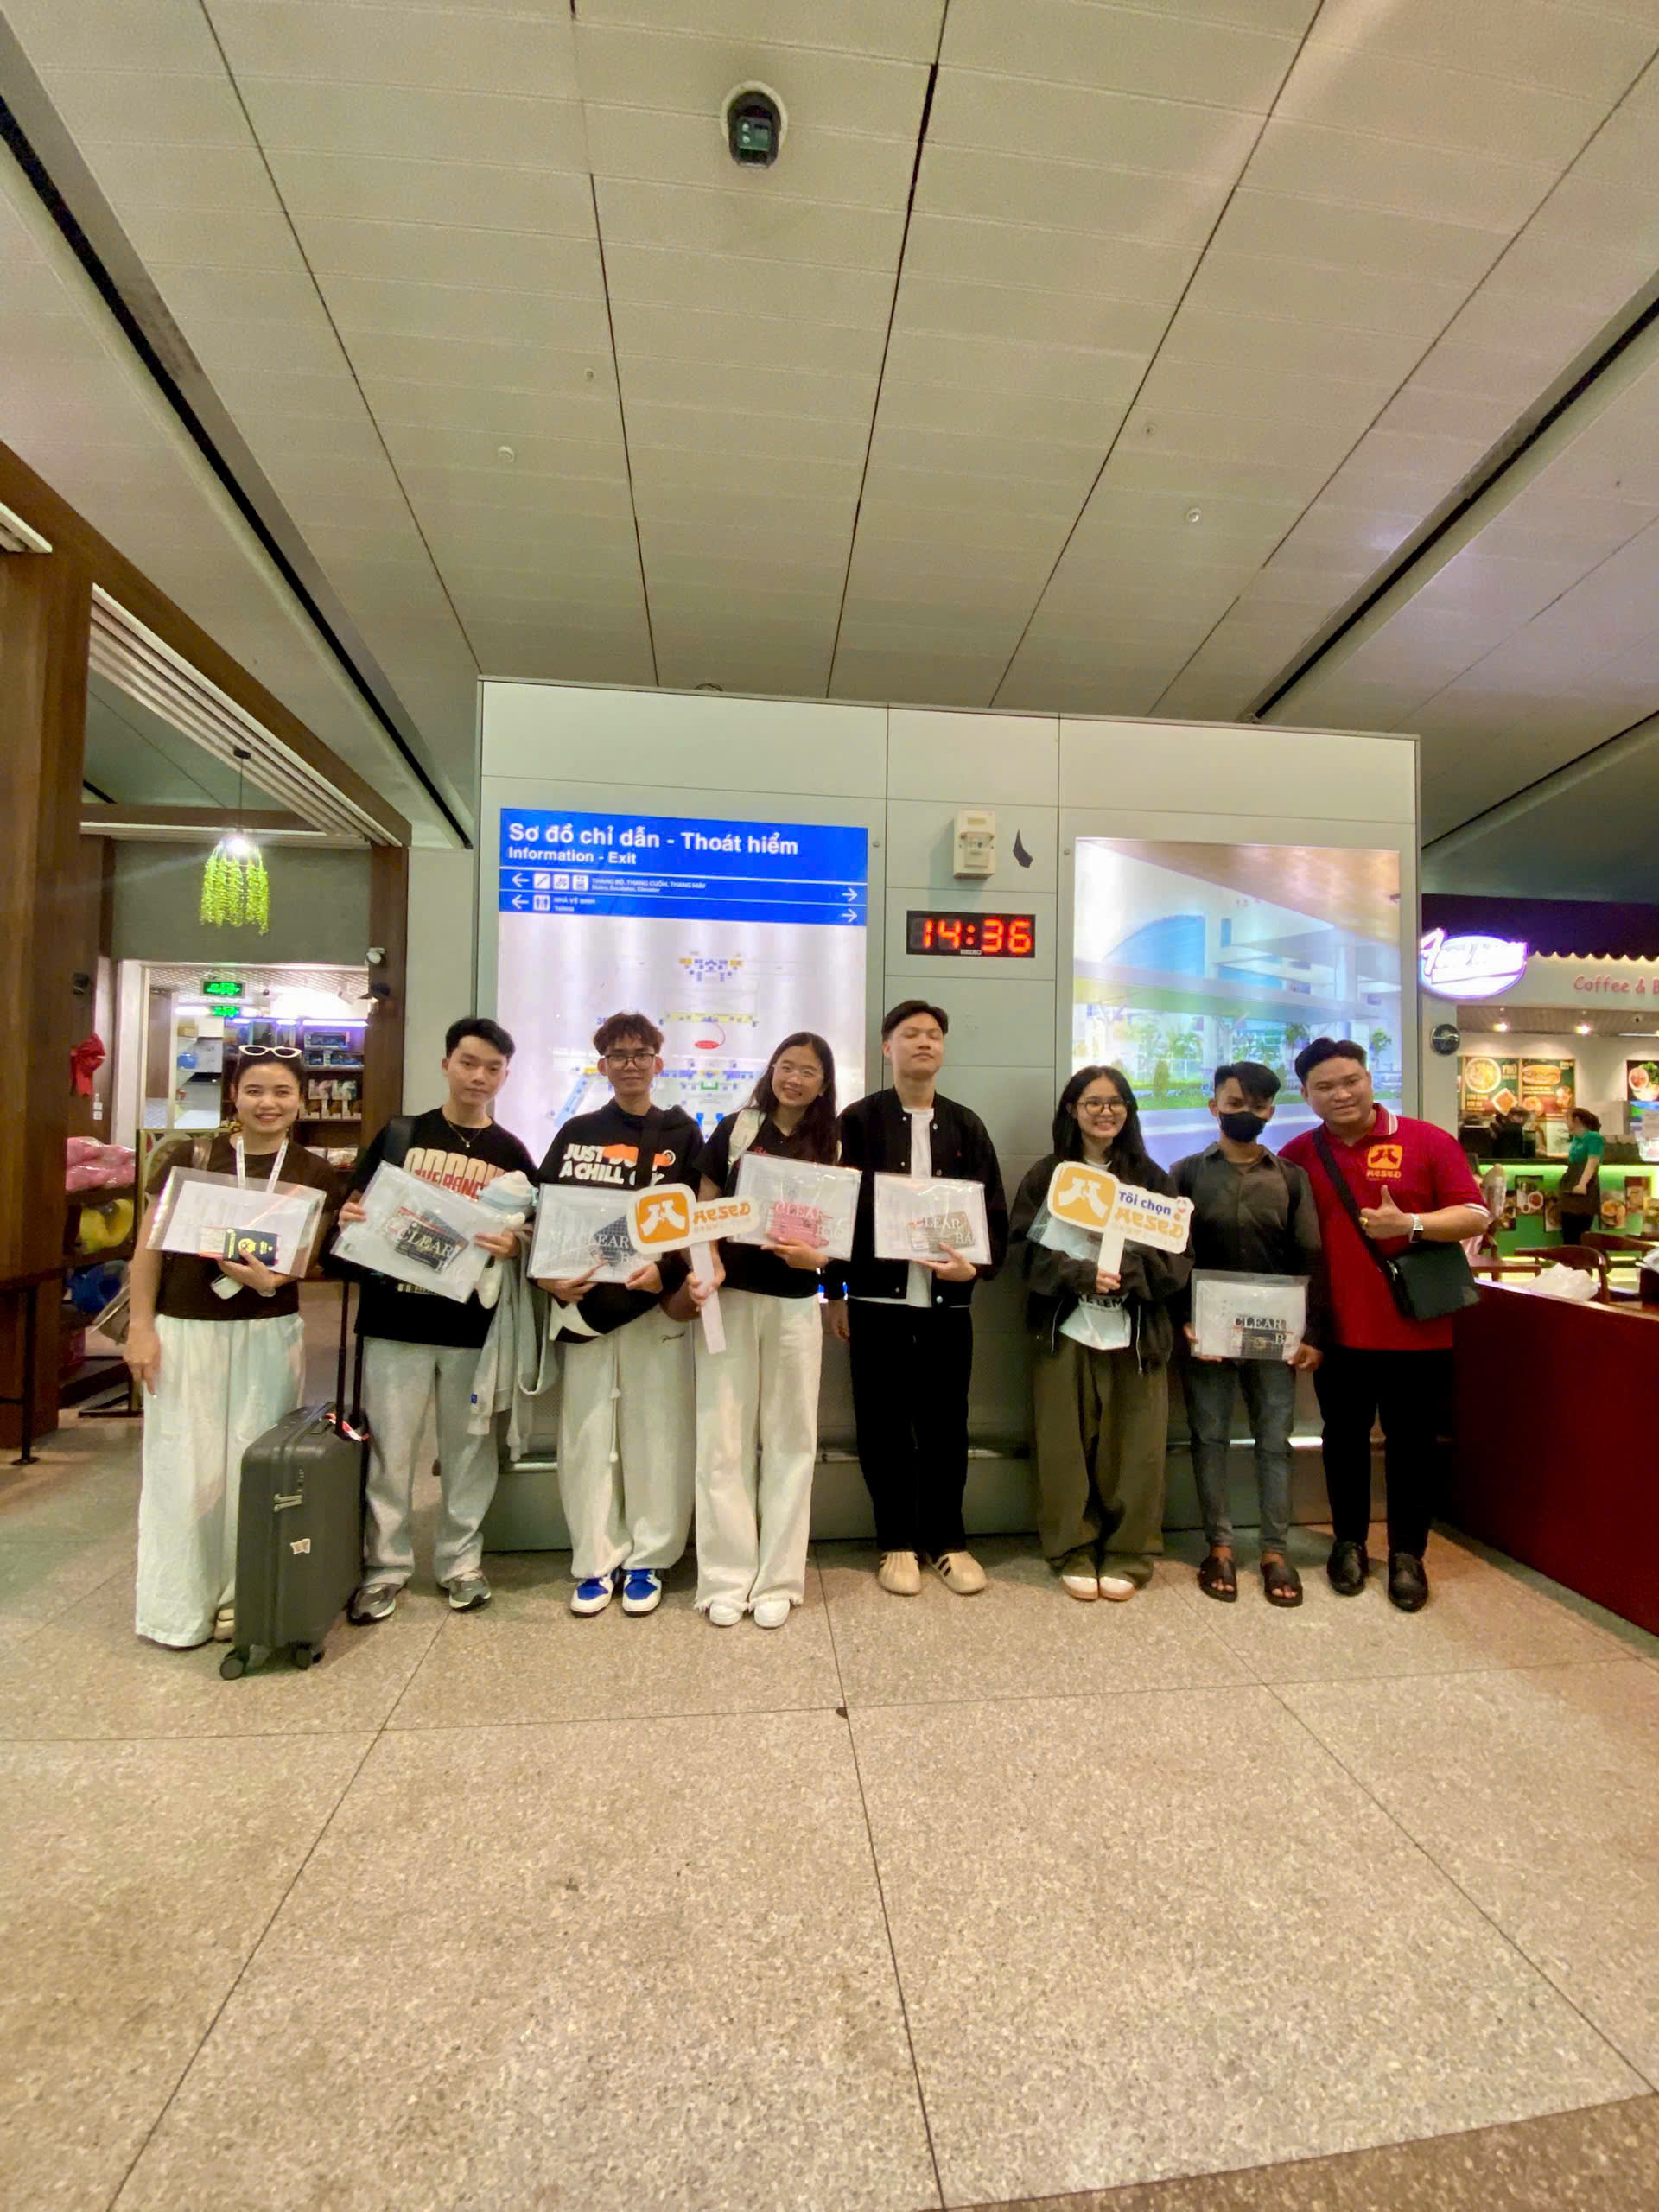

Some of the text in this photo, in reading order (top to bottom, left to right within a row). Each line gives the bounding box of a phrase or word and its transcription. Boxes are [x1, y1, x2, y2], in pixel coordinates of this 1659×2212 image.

[508, 822, 539, 842] Sơ
[545, 823, 574, 844] đồ
[580, 825, 613, 846] chỉ
[620, 826, 660, 849] dẫn
[680, 831, 742, 853] Thoát
[747, 831, 798, 855] hiểm
[508, 846, 594, 863] Information
[607, 851, 637, 865] Exit
[923, 918, 1032, 954] 14:36
[1573, 974, 1630, 994] Coffee
[563, 1143, 604, 1163] JUST
[558, 1160, 573, 1179] A
[574, 1162, 624, 1185] CHILL
[1119, 1191, 1172, 1216] Tôi chọn
